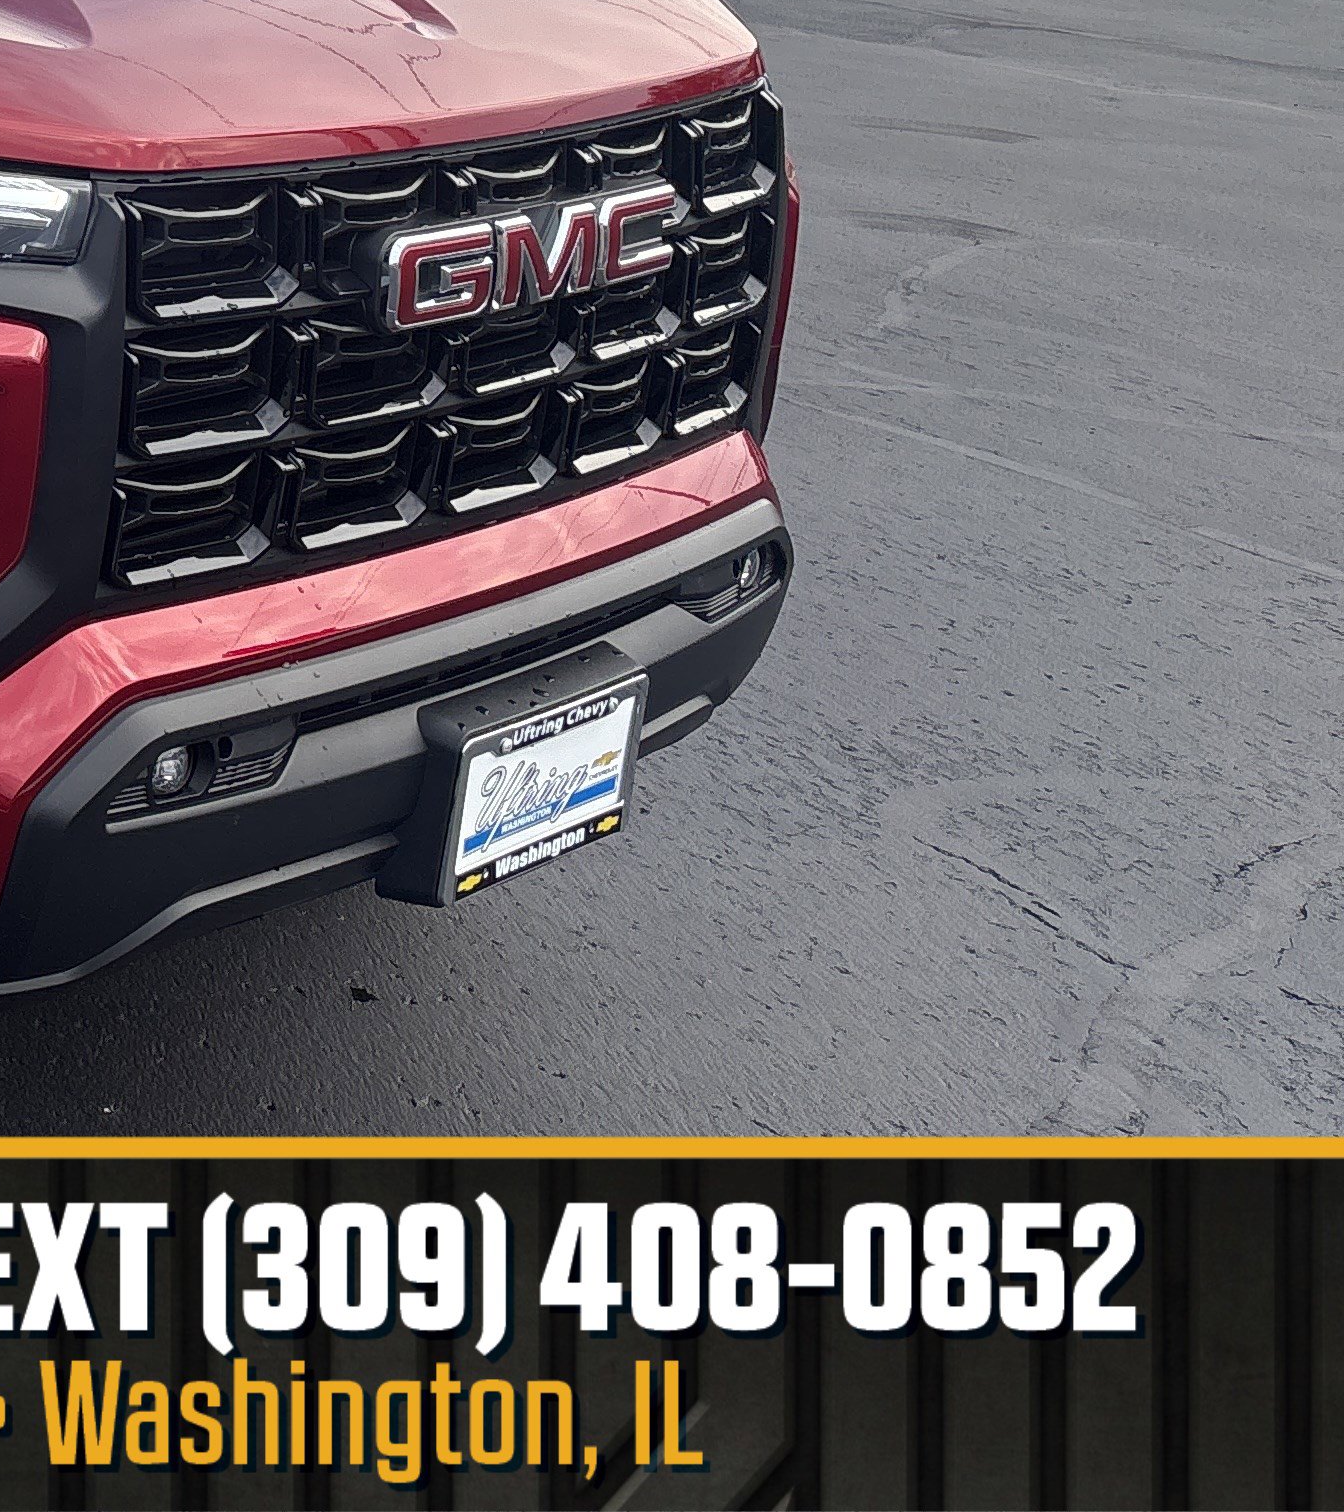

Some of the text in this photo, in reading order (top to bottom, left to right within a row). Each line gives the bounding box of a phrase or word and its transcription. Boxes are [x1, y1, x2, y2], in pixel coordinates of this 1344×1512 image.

[386, 184, 678, 331] GMC
[513, 697, 610, 746] Uftring Chevy
[475, 760, 589, 854] Uftring
[501, 806, 553, 835] WASHINGTON
[494, 826, 587, 879] Washington
